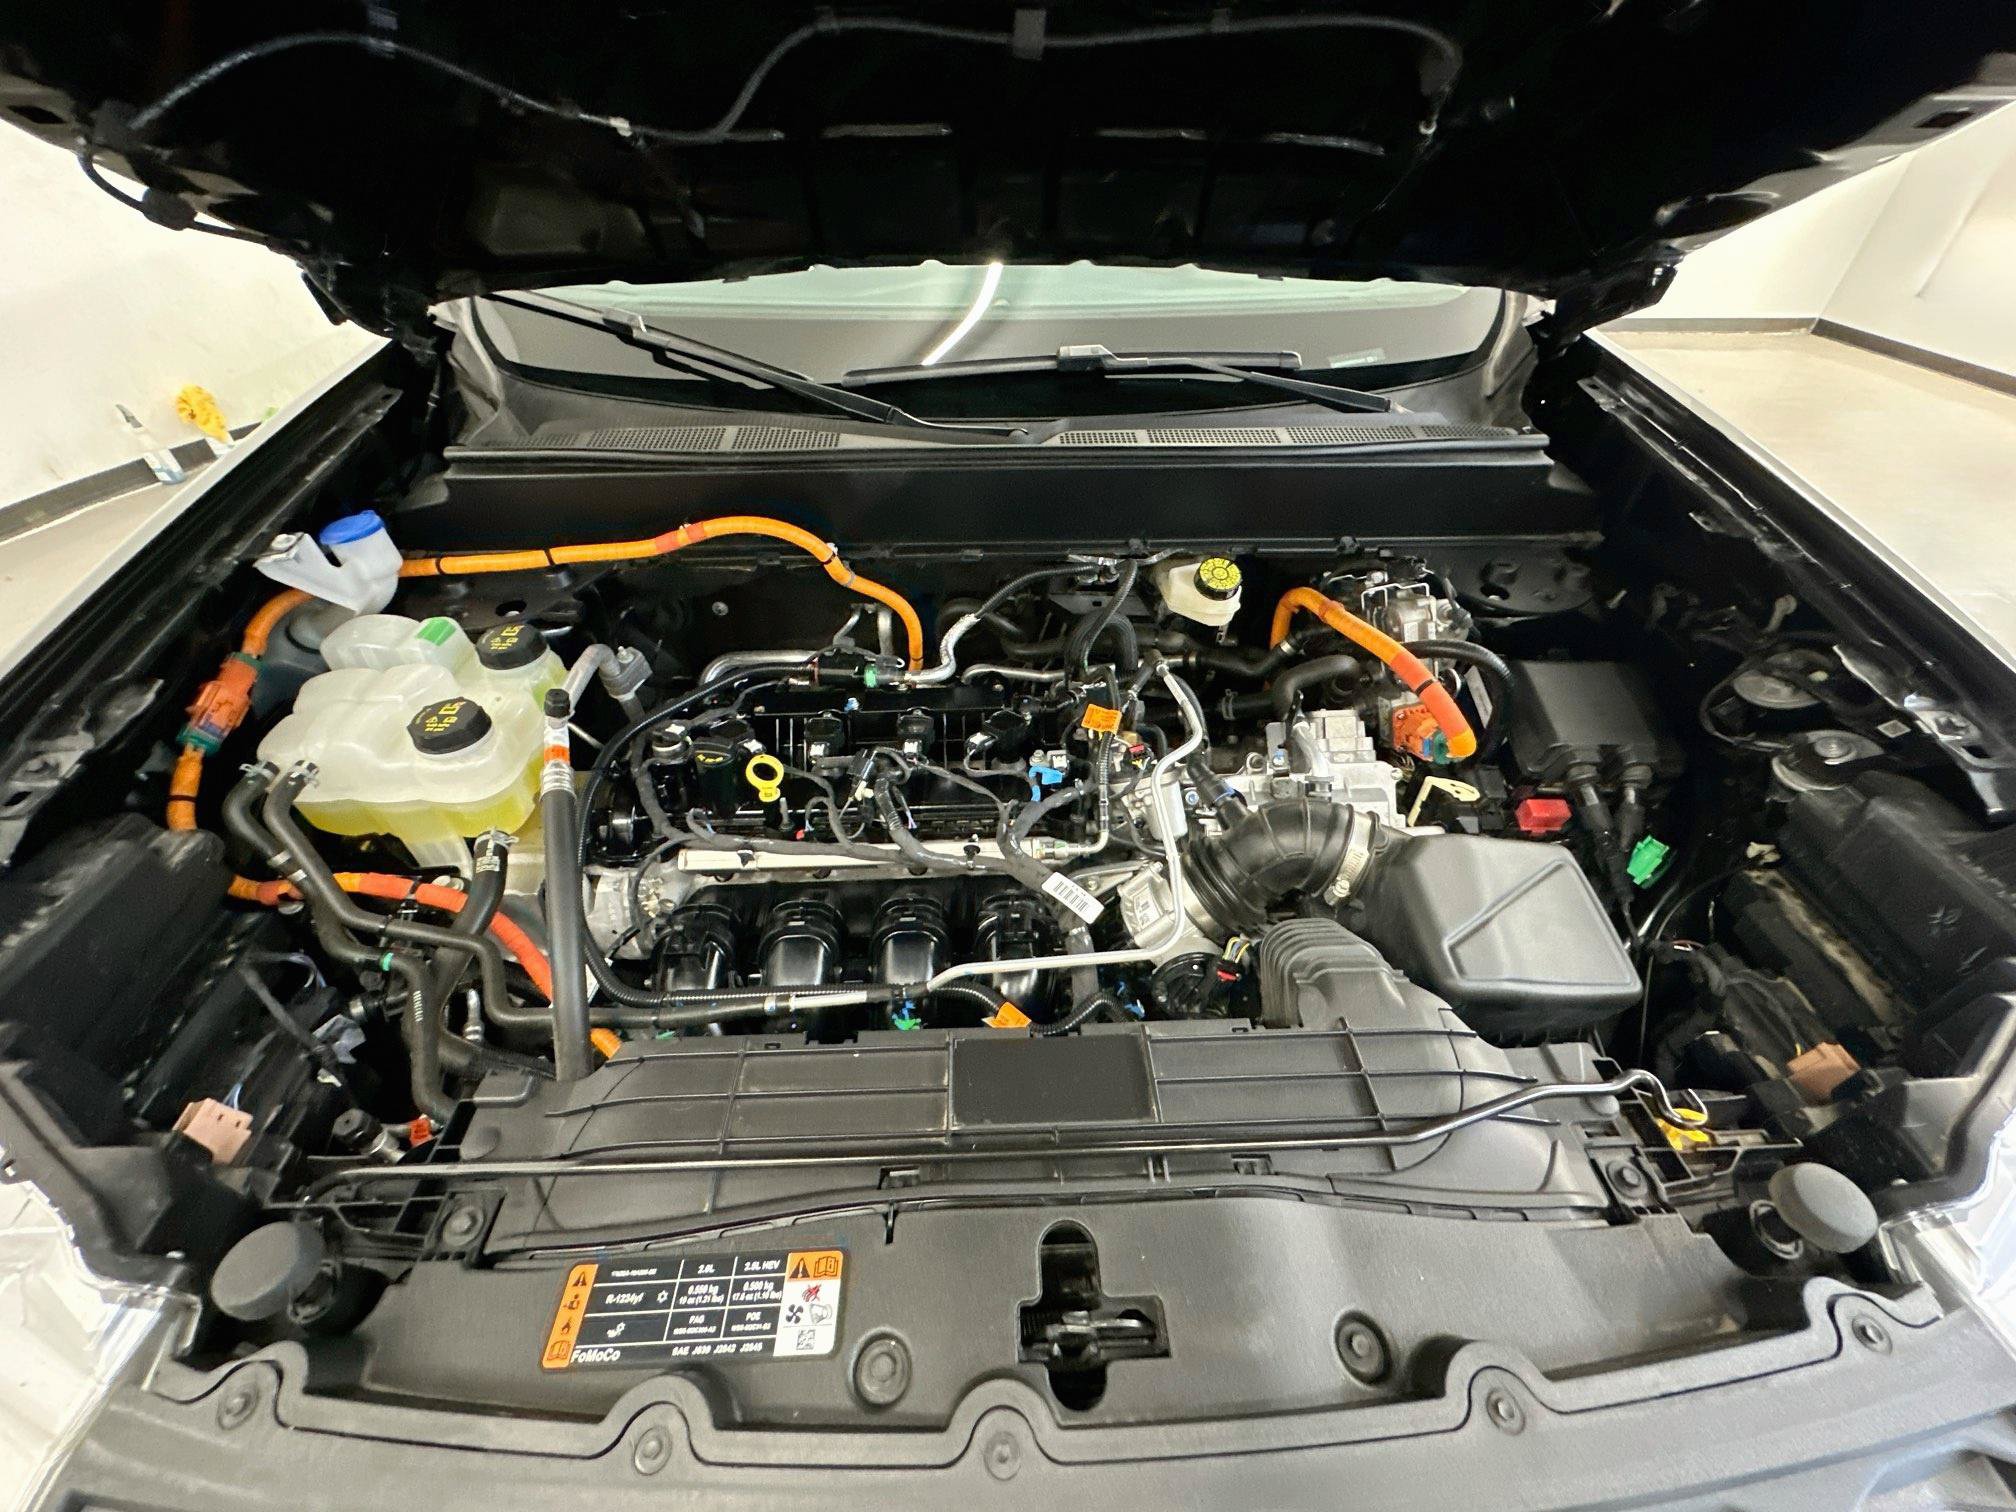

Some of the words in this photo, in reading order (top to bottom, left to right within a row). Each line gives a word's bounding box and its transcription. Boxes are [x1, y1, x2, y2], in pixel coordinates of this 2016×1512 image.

[762, 1259, 780, 1270] HEV
[764, 1280, 775, 1292] kg
[689, 1314, 705, 1325] PAG
[745, 1312, 762, 1321] POE
[571, 1348, 621, 1363] FoMoCo
